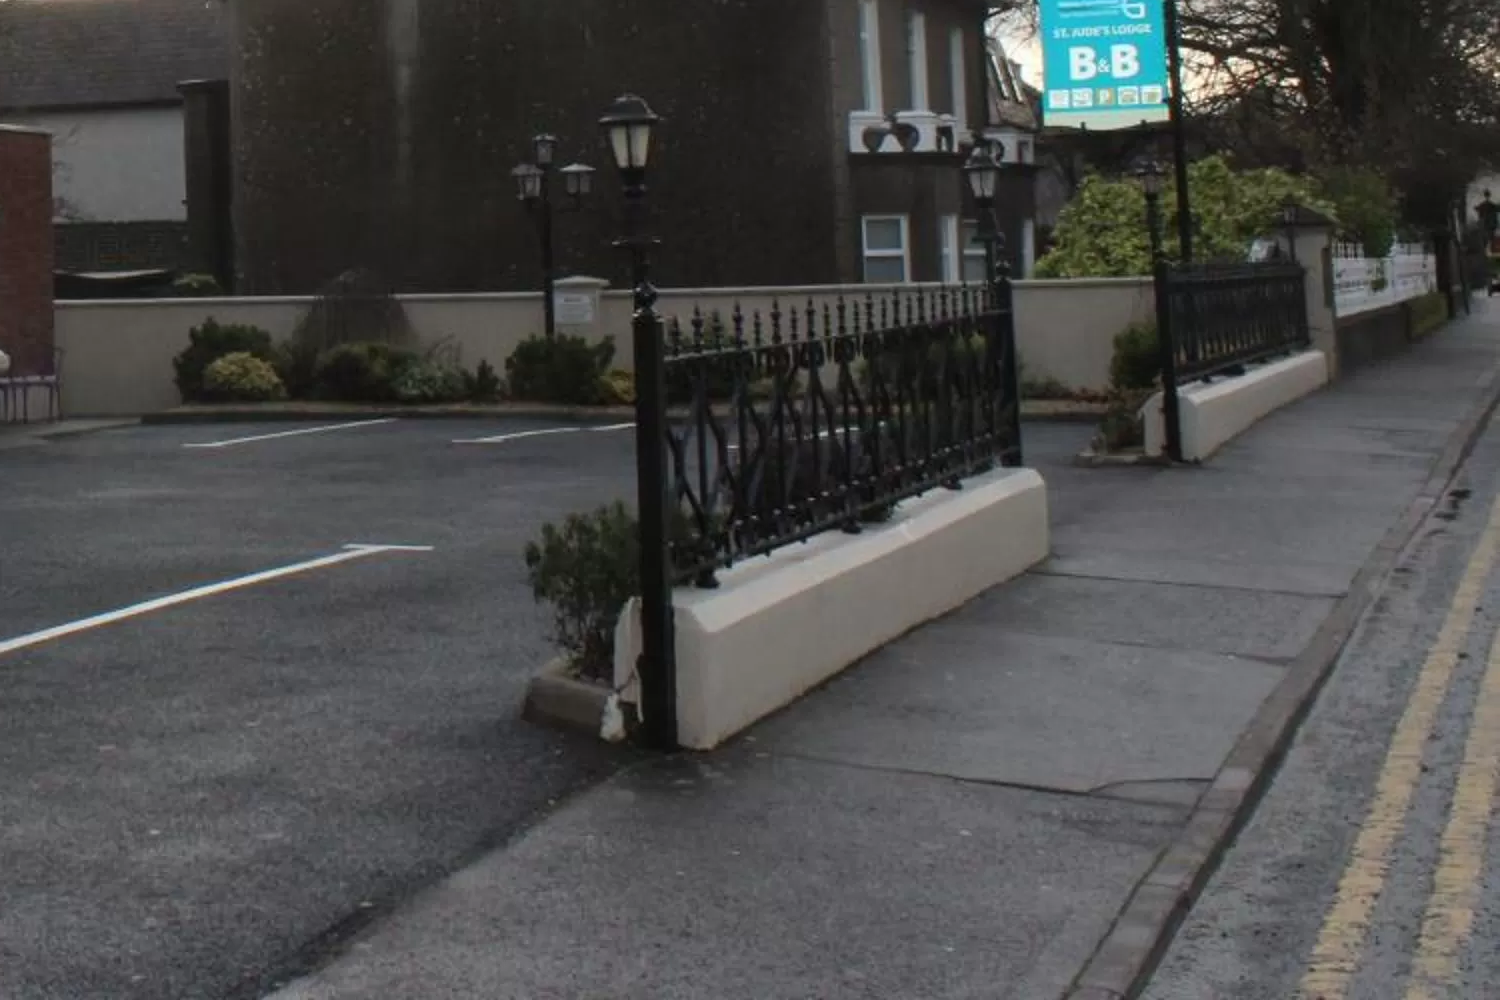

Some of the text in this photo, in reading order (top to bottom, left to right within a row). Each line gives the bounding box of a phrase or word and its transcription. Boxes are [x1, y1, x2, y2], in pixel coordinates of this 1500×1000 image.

[1053, 27, 1069, 39] ST.
[1111, 23, 1152, 36] LODGE
[1068, 44, 1140, 80] B&B
